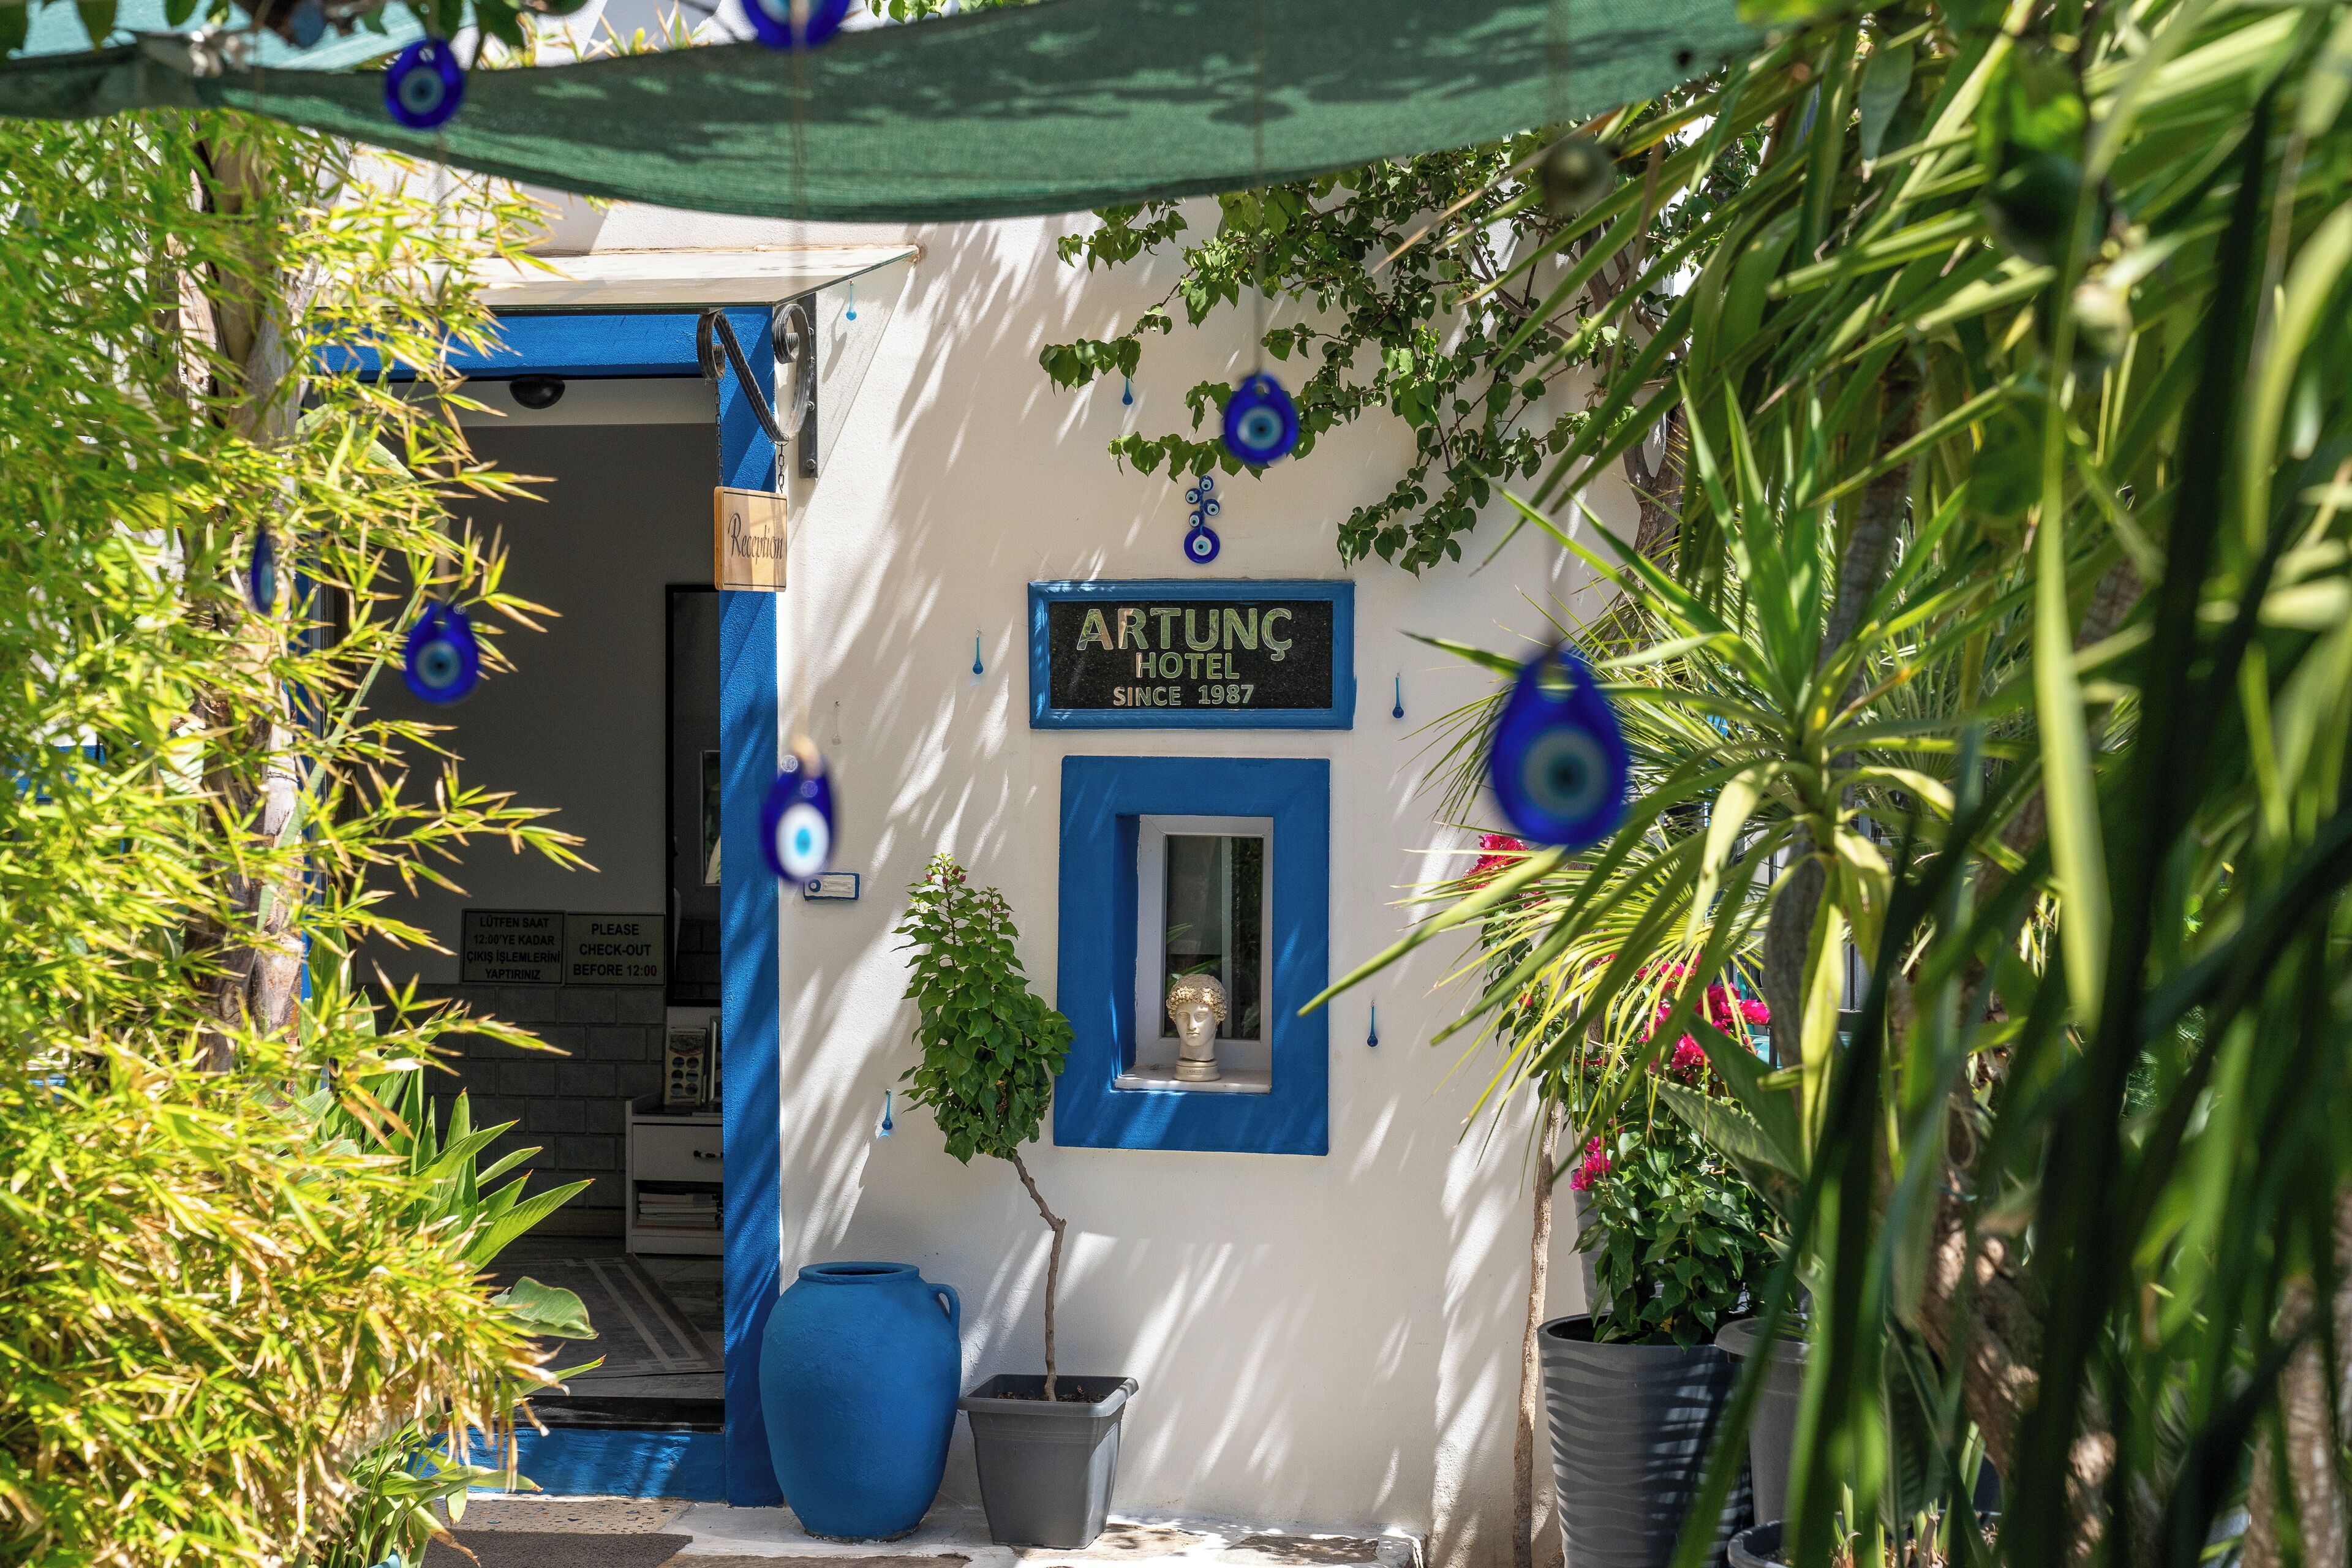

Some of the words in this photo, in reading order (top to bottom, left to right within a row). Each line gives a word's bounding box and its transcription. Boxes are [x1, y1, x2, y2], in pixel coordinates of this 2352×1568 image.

[728, 512, 783, 565] Reception
[1076, 608, 1292, 662] ARTUNÇ
[1135, 652, 1240, 680] HOTEL
[1113, 685, 1182, 707] SINCE
[1198, 684, 1254, 706] 1987
[480, 914, 519, 927] LÜTFEN
[522, 918, 549, 928] SAAT
[591, 923, 639, 936] PLEASE
[474, 934, 516, 944] 12:00'YE
[518, 935, 555, 946] KADAR
[579, 943, 651, 956] CHECK-OUT
[467, 951, 493, 964] ÇIKIŞ
[496, 949, 560, 965] İŞLEMLERİNİ
[485, 968, 541, 980] YAPTIRINIZ
[573, 963, 623, 976] BEFORE
[627, 964, 657, 976] 12:00
